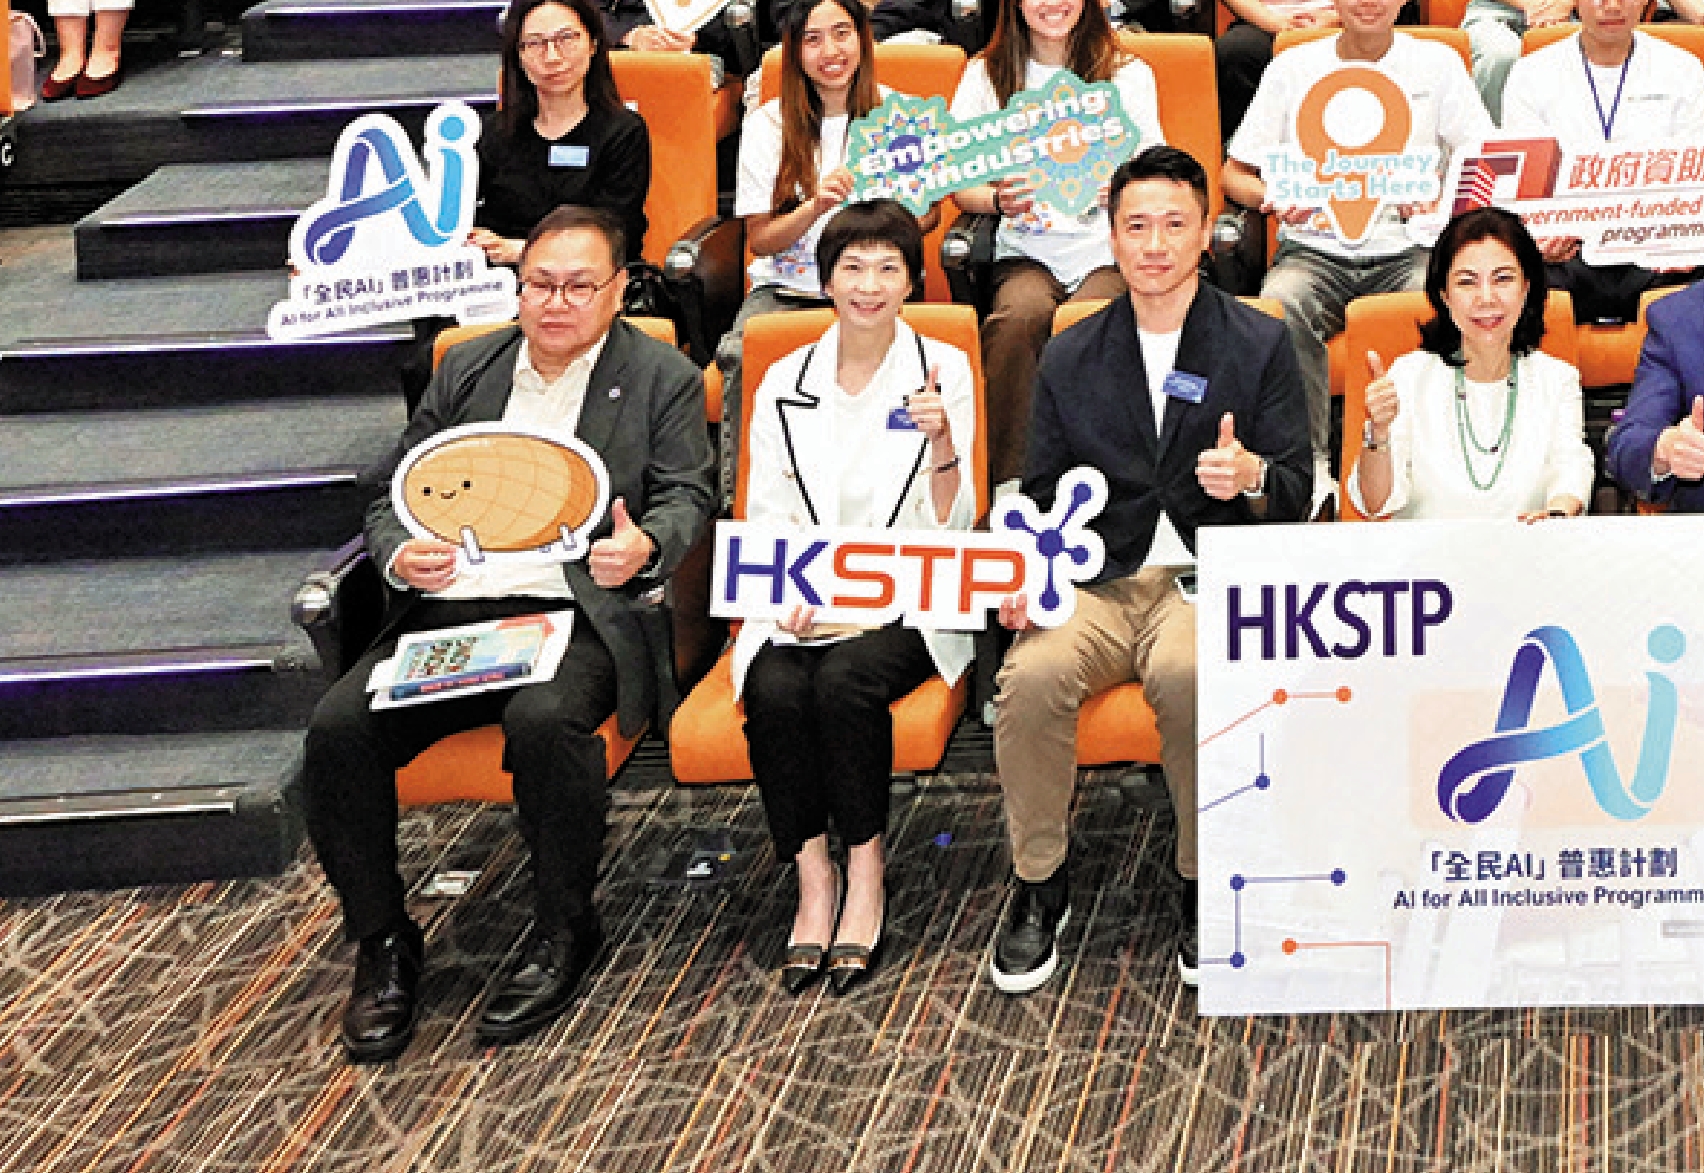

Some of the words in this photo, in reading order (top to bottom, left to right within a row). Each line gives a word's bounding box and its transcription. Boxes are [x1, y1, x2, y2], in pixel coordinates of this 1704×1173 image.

[860, 88, 1108, 176] Empowering
[1266, 153, 1315, 174] The
[1324, 150, 1434, 176] Journey
[1275, 179, 1363, 200] Starts
[1368, 177, 1433, 196] Here
[724, 535, 1026, 614] HKSTP
[1226, 579, 1454, 662] HKSTP
[1422, 888, 1453, 909] for
[1457, 887, 1490, 908] All
[1492, 886, 1588, 908] Inclusive
